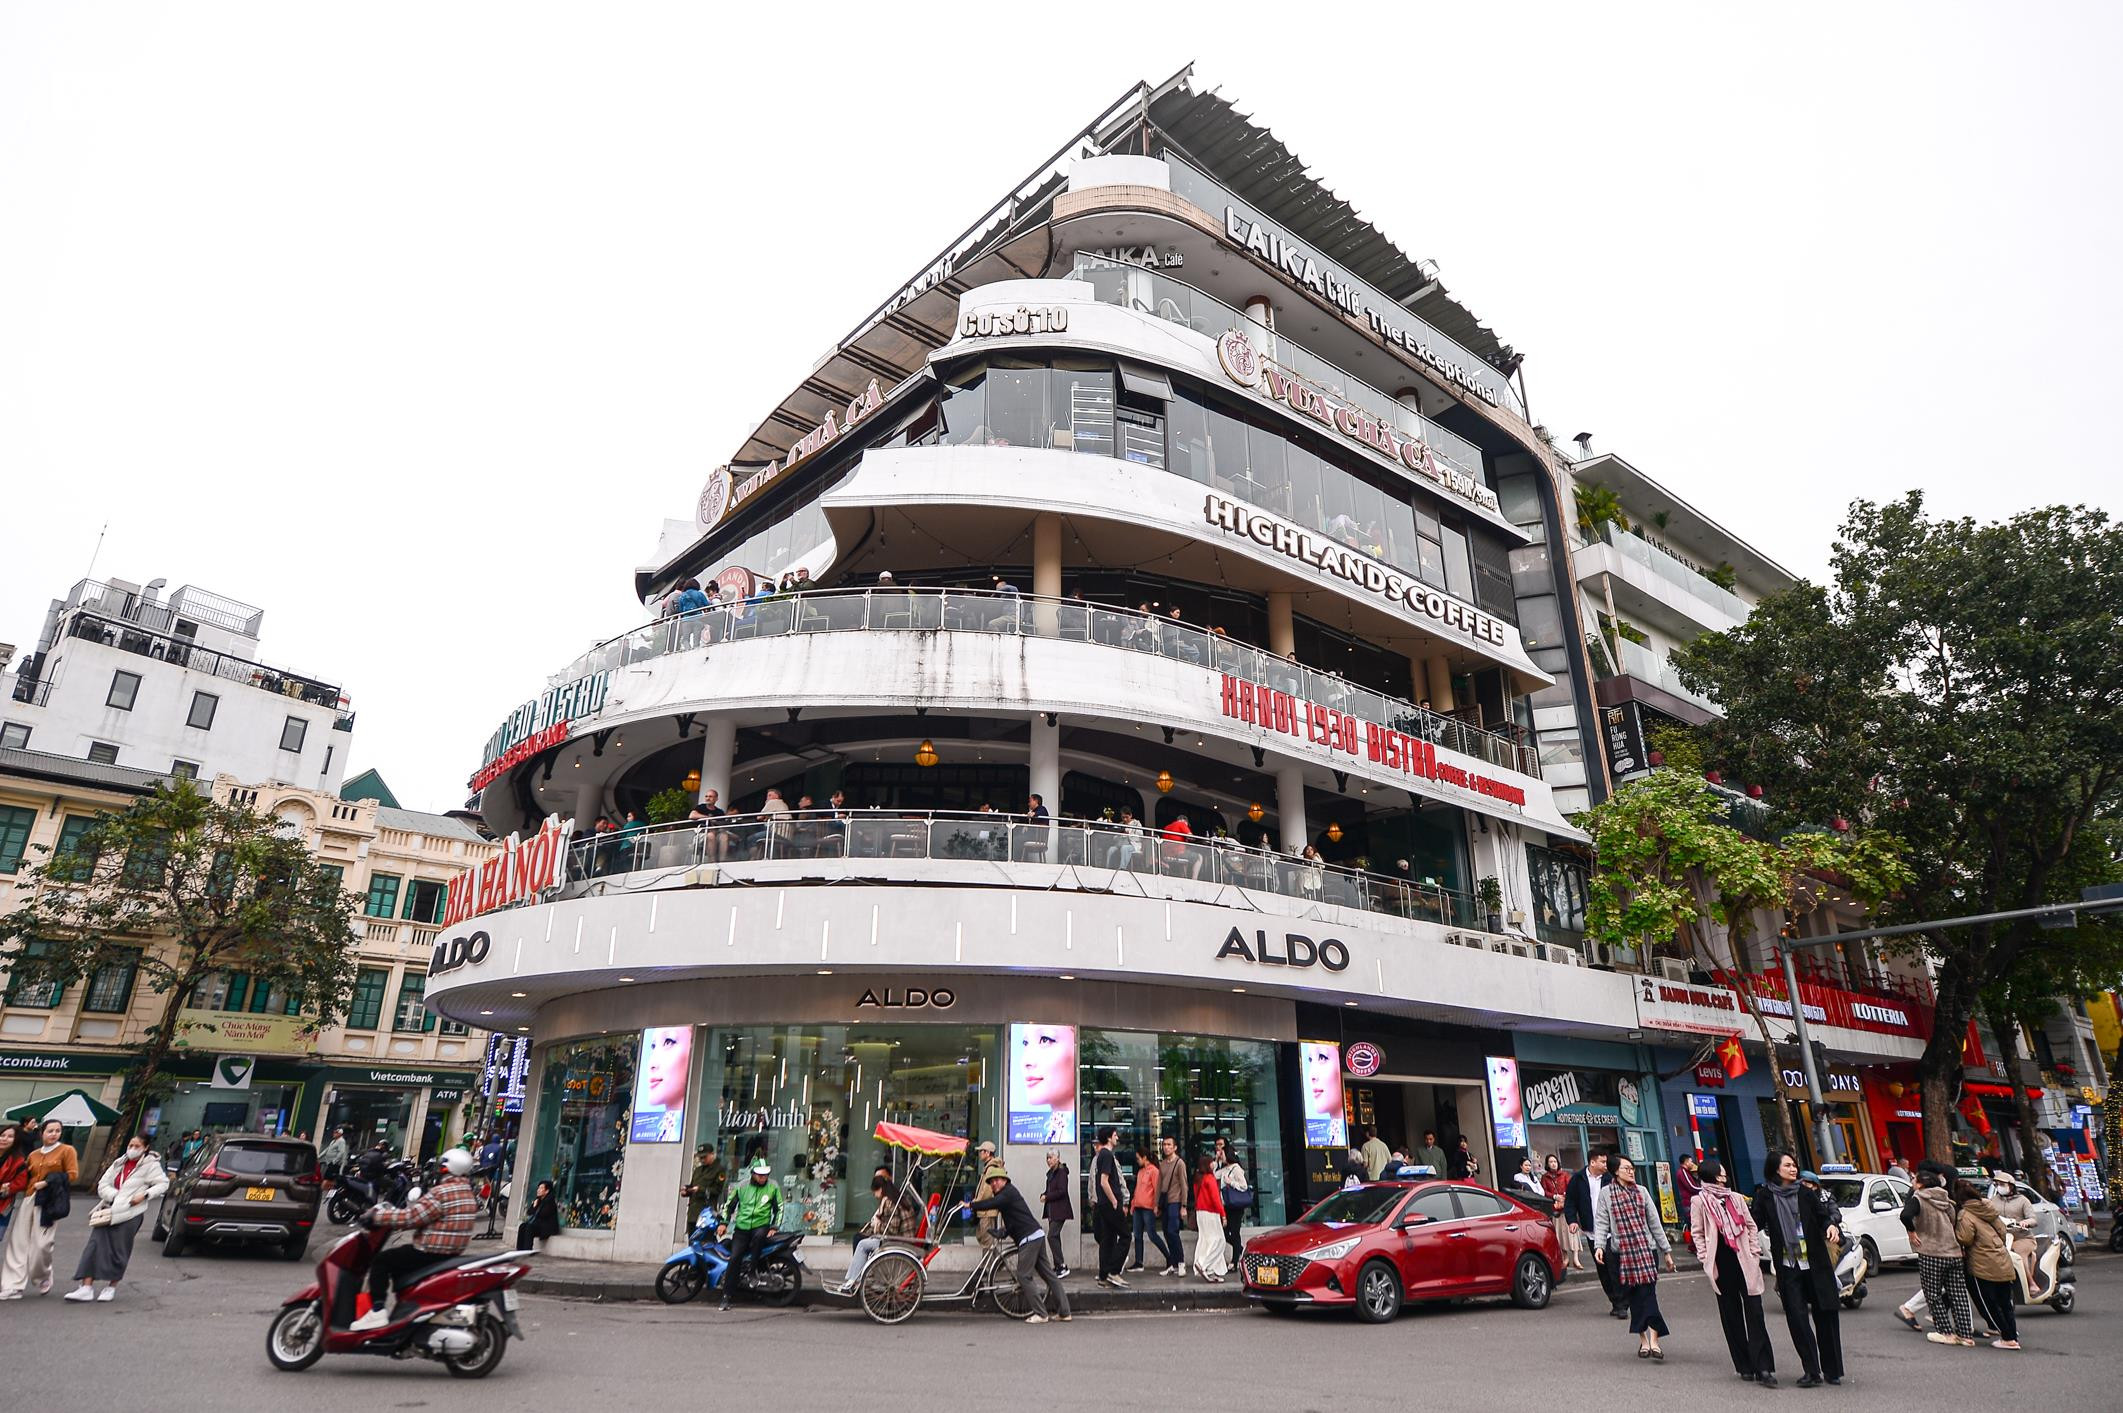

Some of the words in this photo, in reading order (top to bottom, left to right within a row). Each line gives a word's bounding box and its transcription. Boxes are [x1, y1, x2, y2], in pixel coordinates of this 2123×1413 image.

[1036, 305, 1068, 334] 10
[1225, 205, 1323, 292] LAIKA
[1324, 270, 1361, 318] Café
[1366, 307, 1402, 343] The
[1404, 331, 1499, 408] Exceptional
[1333, 406, 1400, 461] CHẢ
[1204, 494, 1404, 601] HIGHLANDS
[1403, 585, 1504, 647] COFFEE
[541, 668, 609, 732] BISTRO
[1220, 672, 1299, 737] HANOI
[1305, 700, 1358, 756] 1930
[1366, 721, 1438, 781] BISTRO
[441, 868, 475, 929] BIA
[1216, 926, 1350, 973] ALDO
[856, 988, 957, 1009] ALDO
[1851, 1003, 1909, 1026] LOTTERIA
[1348, 1044, 1378, 1059] HIGHLANDS
[370, 1071, 434, 1083] Vietcombank
[1352, 1065, 1375, 1075] COFFEE
[436, 1090, 457, 1099] ATM
[1556, 1112, 1587, 1124] HOMEMADE
[1325, 1151, 1333, 1169] 1
